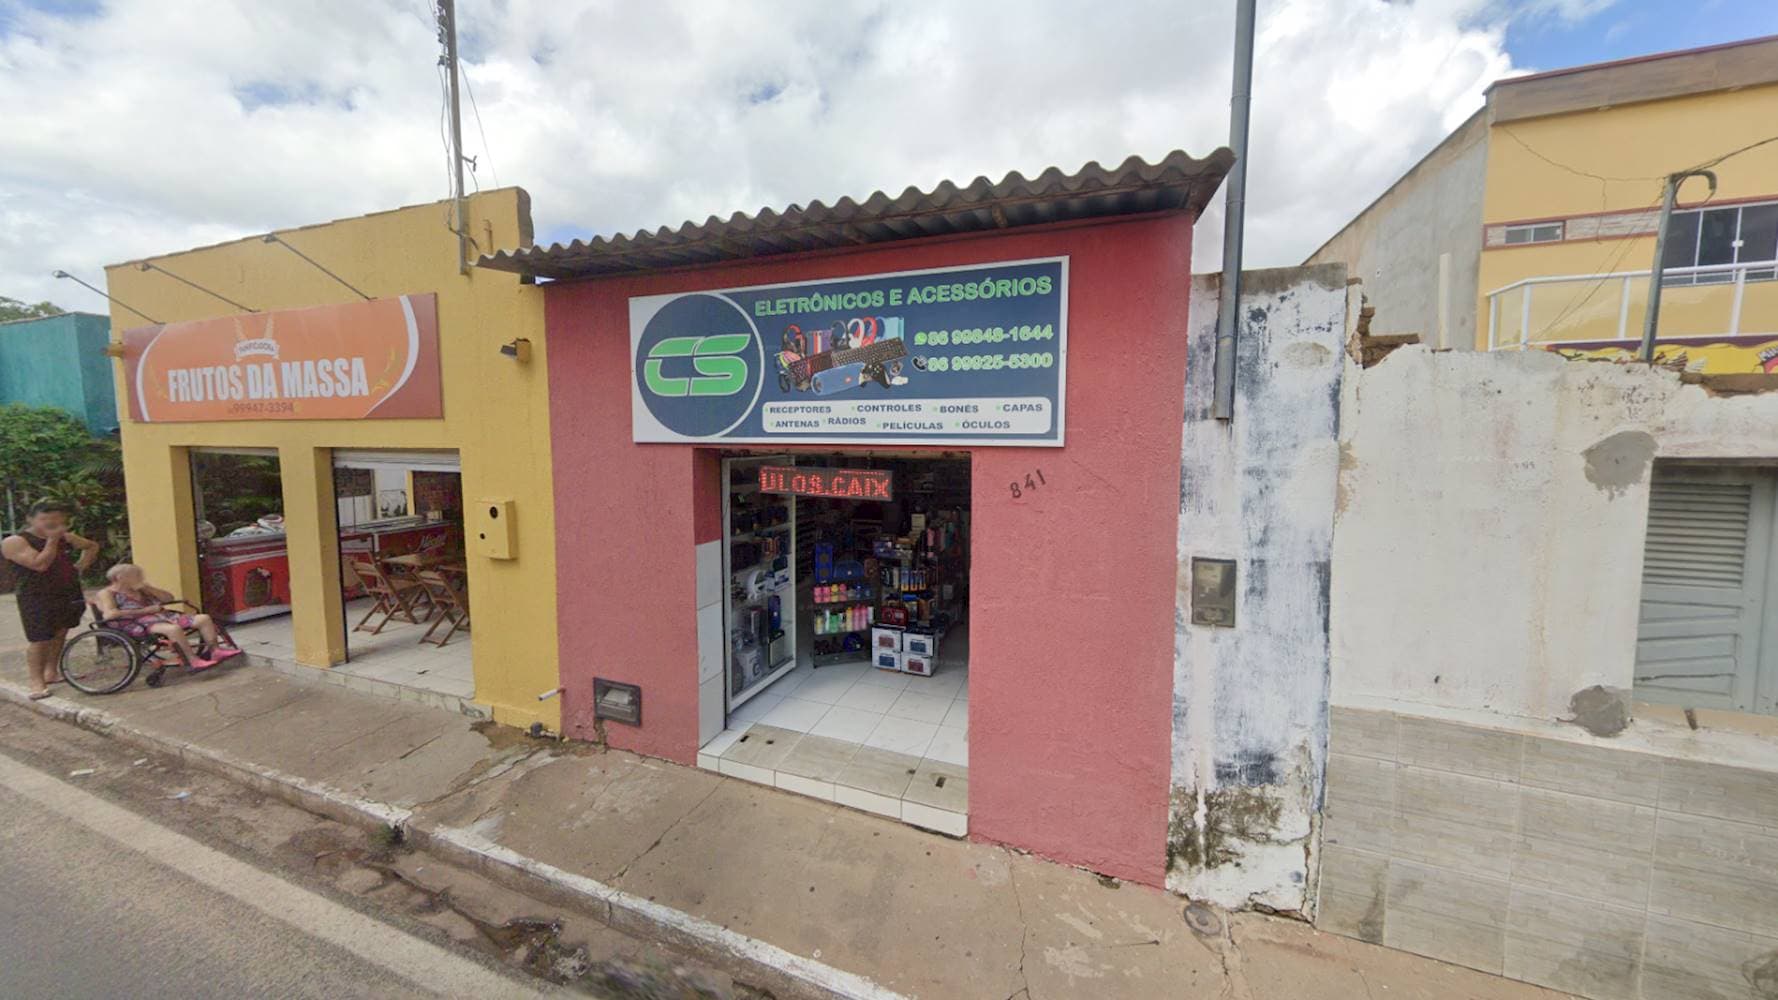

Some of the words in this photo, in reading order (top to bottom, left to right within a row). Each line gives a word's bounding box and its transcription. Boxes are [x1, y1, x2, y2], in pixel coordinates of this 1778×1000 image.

[755, 289, 885, 317] ELETRÔNICOS
[889, 288, 903, 306] E
[907, 275, 1053, 306] ACESSÓRIOS
[167, 364, 242, 403] FRUTOS
[246, 362, 279, 399] DA
[280, 357, 370, 398] MASSA
[769, 405, 832, 414] RECEPTORES
[856, 403, 922, 413] CONTROLES
[1002, 403, 1043, 412] CAPAS
[775, 419, 820, 428] ANTENAS
[827, 416, 867, 425] RÁDIOS
[882, 421, 944, 430] PELÍCULAS
[961, 419, 1011, 429] ÓCULOS
[1009, 469, 1047, 499] 841
